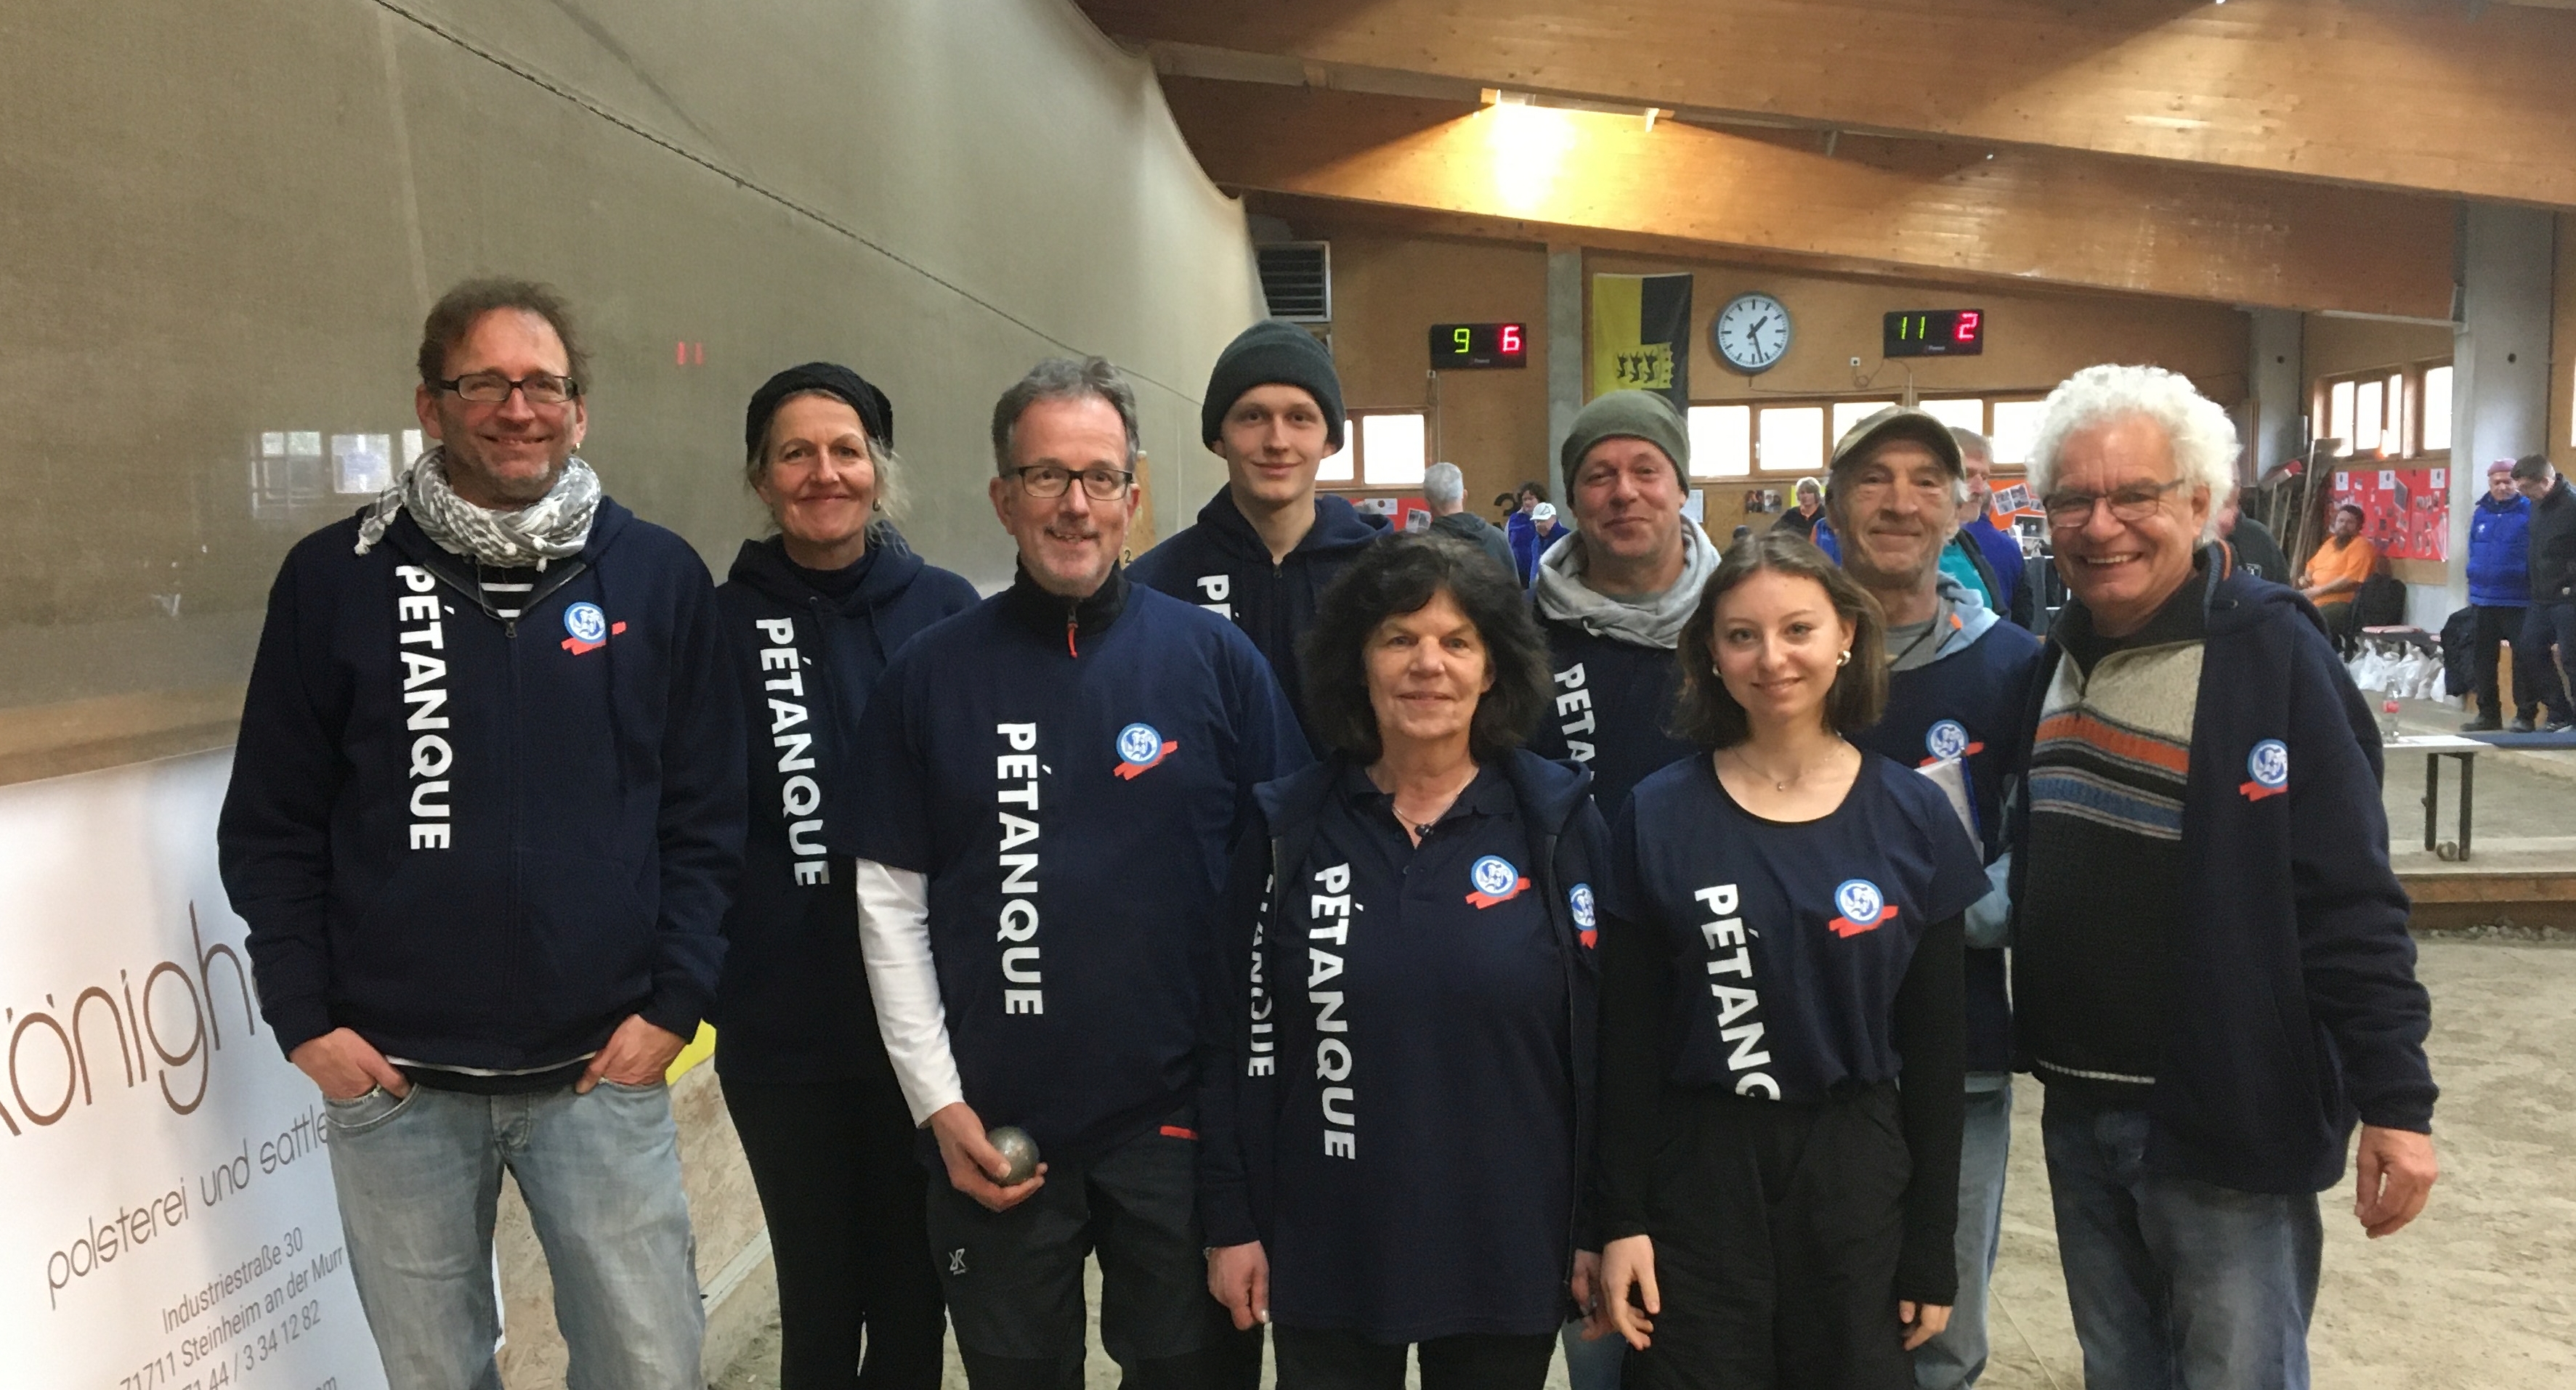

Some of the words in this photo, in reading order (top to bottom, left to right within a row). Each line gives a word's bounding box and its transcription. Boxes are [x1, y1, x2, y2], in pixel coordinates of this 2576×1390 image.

[1454, 328, 1470, 353] 9
[1502, 326, 1520, 352] 6
[1901, 316, 1925, 340] 11
[1959, 313, 1979, 339] 2
[396, 566, 454, 850] PÉTANQUE
[756, 617, 830, 886] PÉTANQUE
[997, 723, 1052, 1015] PÉTANQUE
[0, 899, 255, 1137] önigh
[1308, 863, 1364, 1160] PÉTANQUE
[48, 1176, 189, 1311] polsterei
[201, 1137, 251, 1206] und
[260, 1104, 328, 1174] sattle
[162, 1244, 282, 1334] Industriestraße
[283, 1227, 303, 1257] 30
[182, 1301, 262, 1367] Steinheim
[264, 1287, 283, 1314] an
[286, 1272, 308, 1298] der
[311, 1246, 343, 1283] Murr
[243, 1344, 254, 1370] 3
[257, 1328, 278, 1362] 34
[281, 1314, 300, 1344] 12
[301, 1299, 321, 1330] 82
